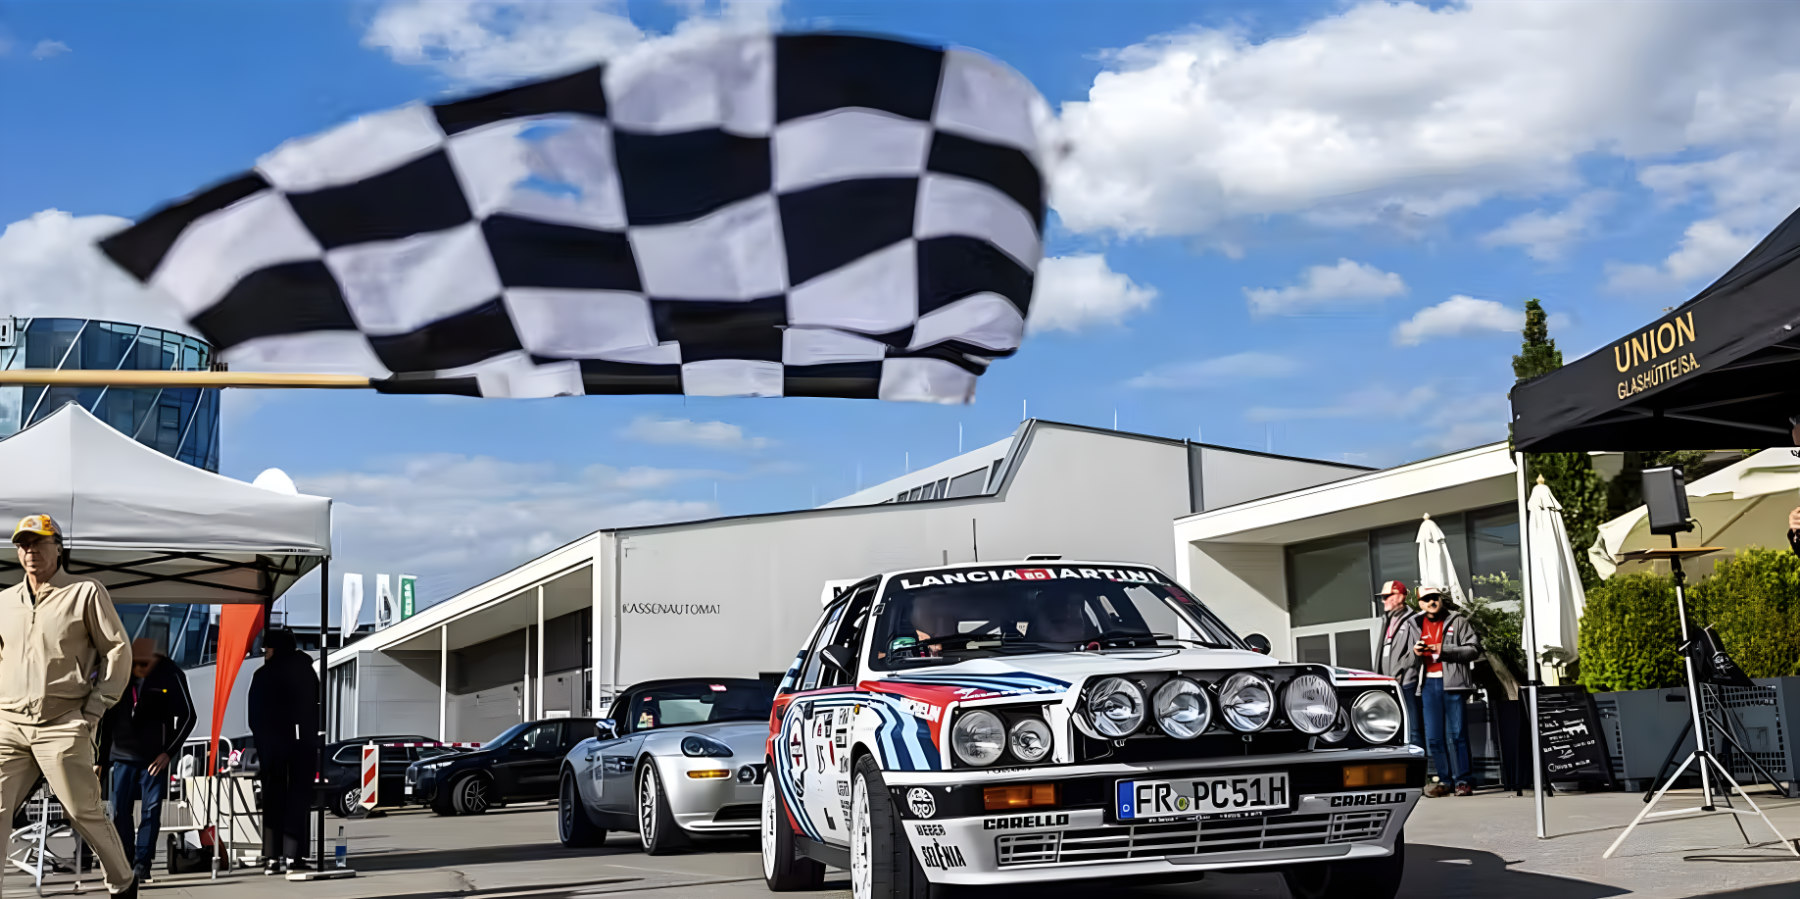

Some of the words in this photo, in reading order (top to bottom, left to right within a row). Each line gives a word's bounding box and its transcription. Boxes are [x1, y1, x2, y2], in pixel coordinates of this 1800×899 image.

[1614, 311, 1696, 373] UNION
[900, 569, 1022, 590] LANCIA
[1136, 783, 1172, 814] FR
[1192, 776, 1286, 810] PC51H
[1330, 792, 1407, 807] CARELLO
[983, 814, 1069, 830] CARELLO
